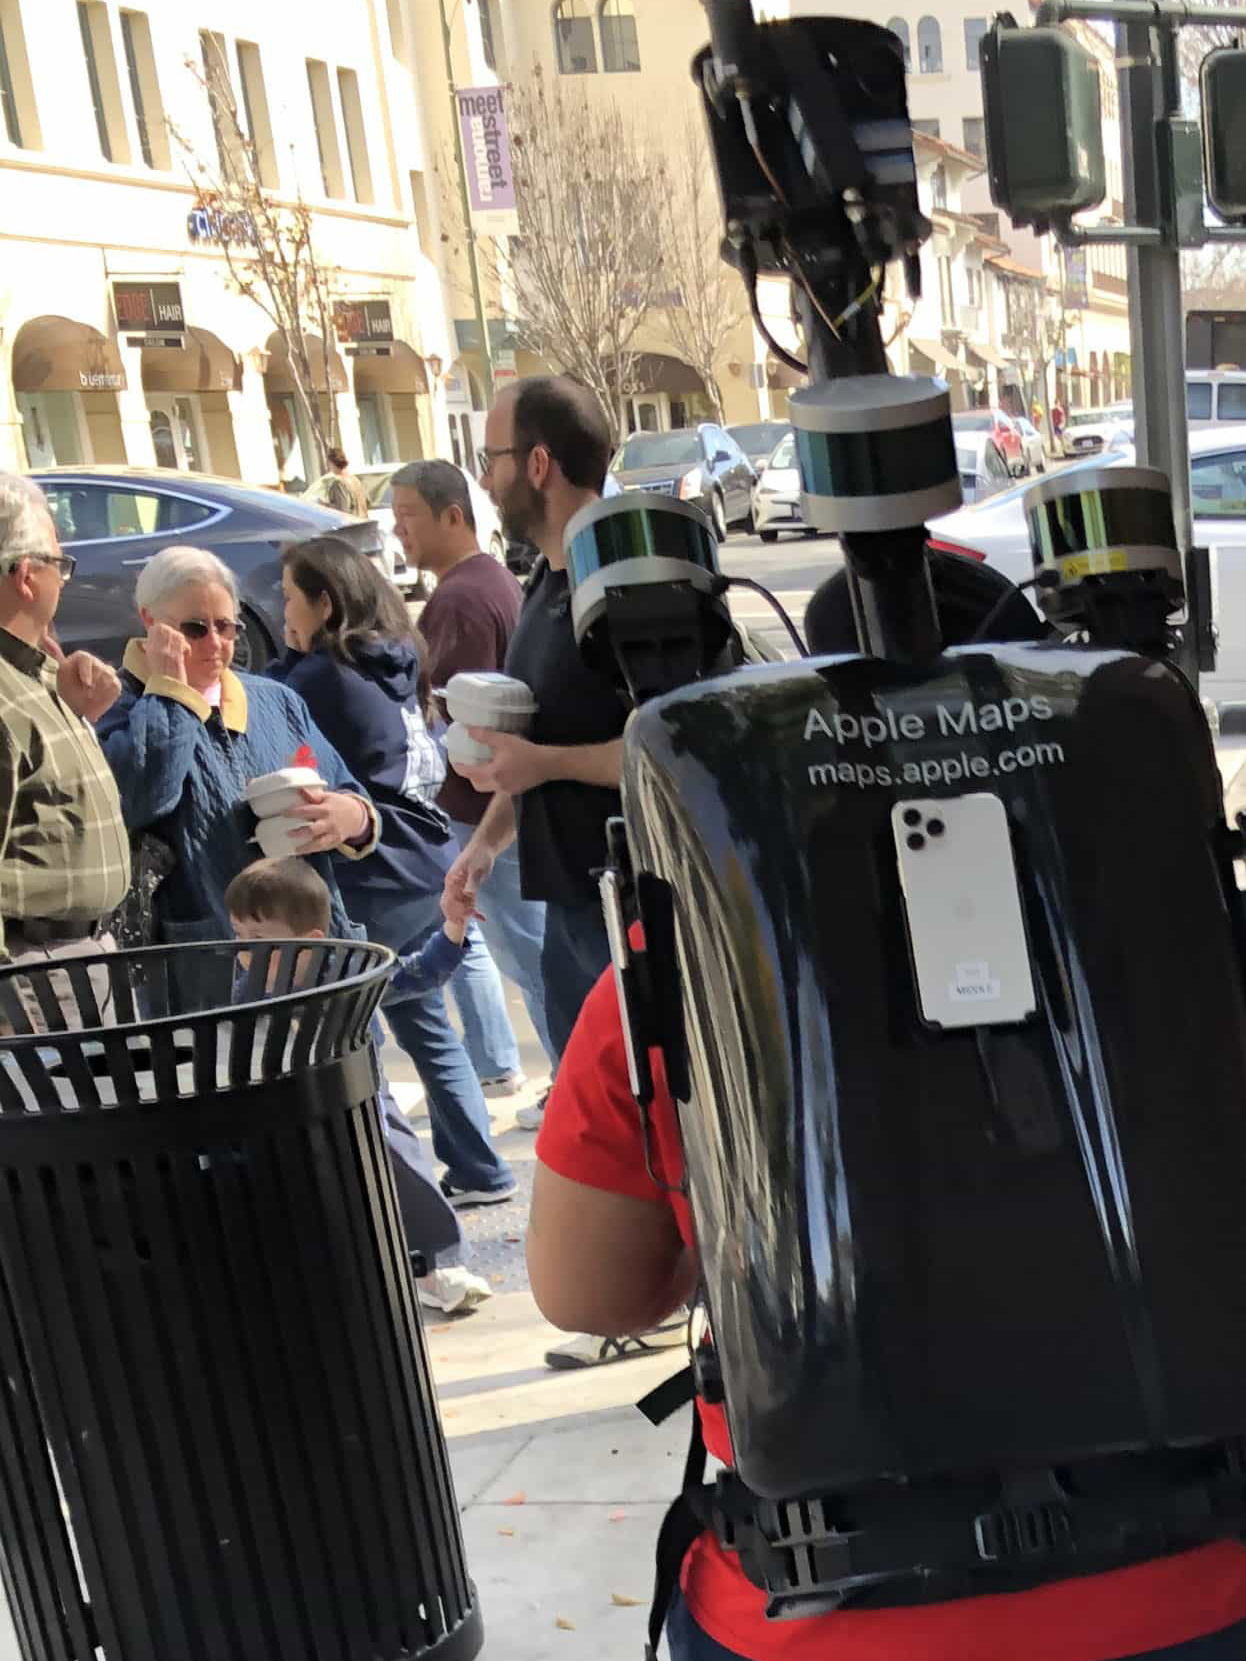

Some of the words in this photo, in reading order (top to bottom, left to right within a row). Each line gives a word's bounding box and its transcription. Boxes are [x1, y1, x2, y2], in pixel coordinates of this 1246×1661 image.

[458, 90, 504, 116] meet
[482, 114, 508, 189] street
[158, 304, 183, 322] HAIR
[803, 707, 927, 749] Apple
[935, 694, 1055, 737] Maps
[807, 741, 1066, 790] maps.apple.com
